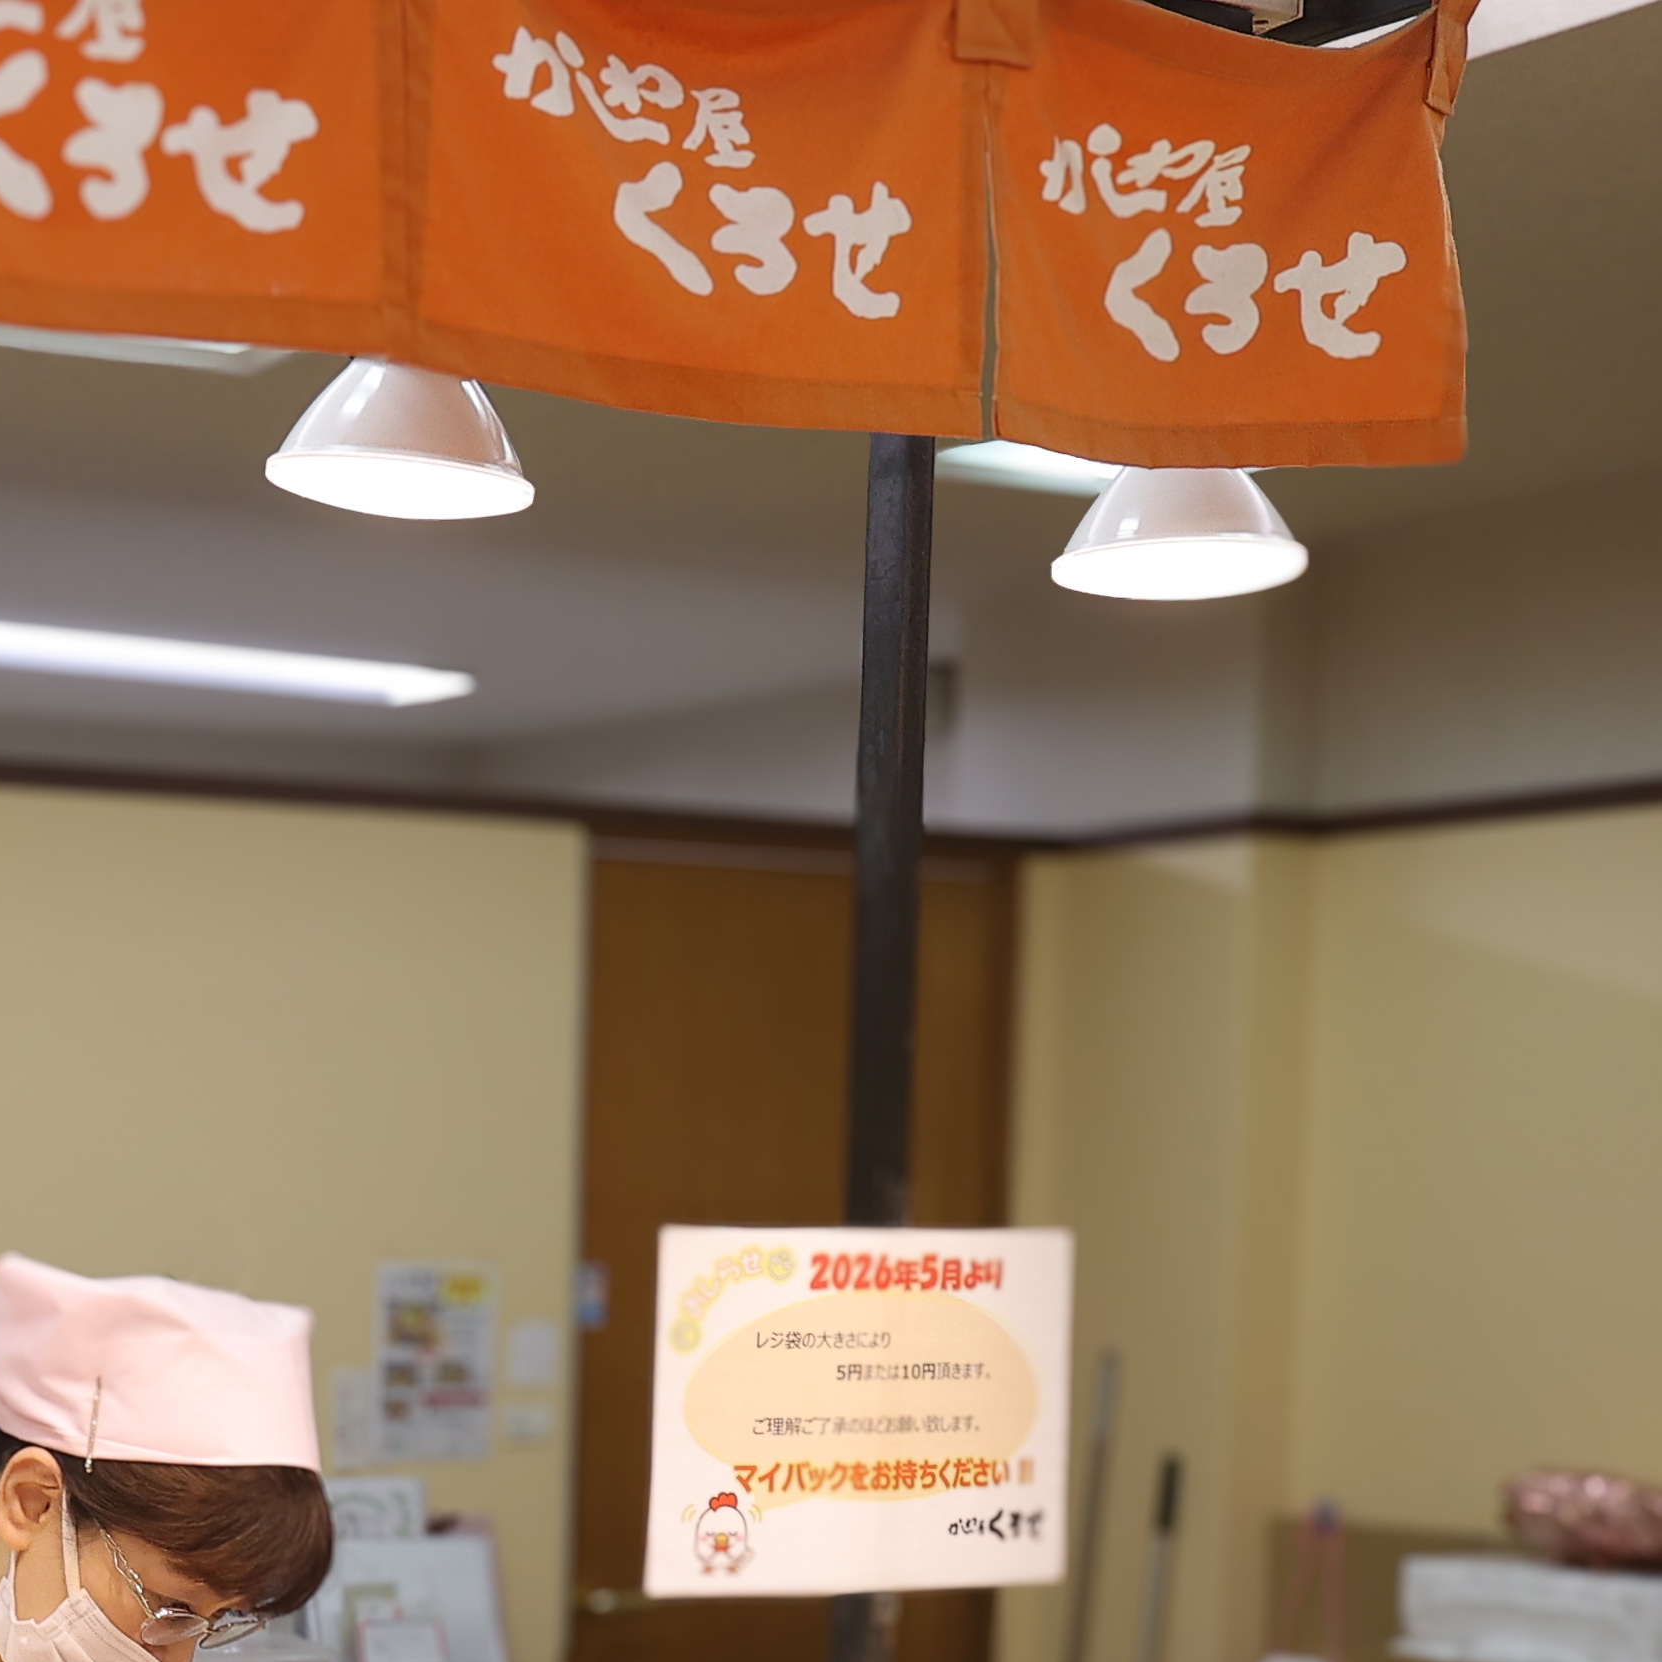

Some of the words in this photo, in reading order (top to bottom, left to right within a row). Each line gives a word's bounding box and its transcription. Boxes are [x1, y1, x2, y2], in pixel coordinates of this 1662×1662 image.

[614, 161, 911, 319] くろせ
[1104, 228, 1406, 361] くろせ
[808, 1252, 1003, 1291] 2026年5月より
[755, 1331, 891, 1349] レジ袋の大きさにより
